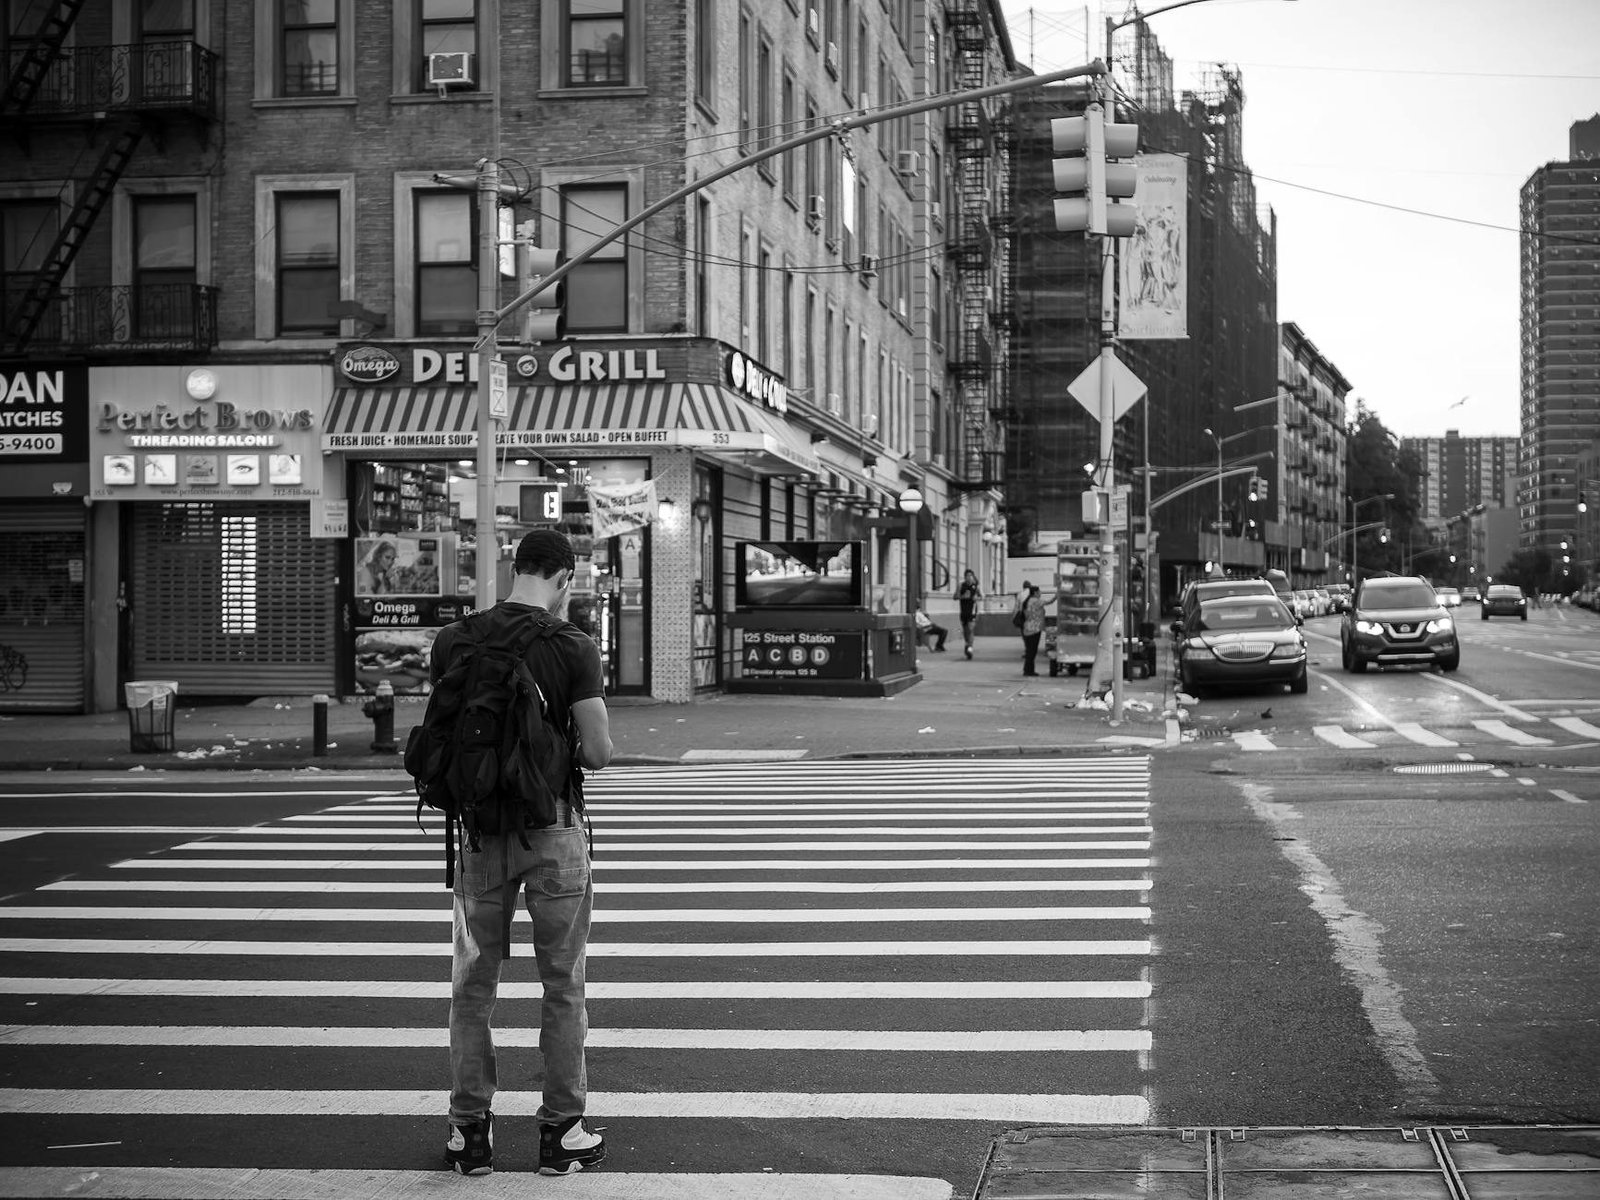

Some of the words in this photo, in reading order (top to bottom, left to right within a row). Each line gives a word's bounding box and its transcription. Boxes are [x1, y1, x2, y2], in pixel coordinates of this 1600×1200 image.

[343, 357, 399, 377] Omega
[550, 346, 665, 381] GRILL
[0, 371, 63, 404] AN
[96, 402, 208, 431] Perfect
[215, 402, 314, 431] Brows
[131, 435, 217, 447] THREADING
[330, 435, 358, 446] FRESH
[361, 435, 385, 446] JUICE
[394, 434, 445, 445] HOMEMADE
[449, 434, 473, 445] SOUP
[518, 433, 542, 444] YOUR
[545, 432, 567, 443] OWN
[570, 432, 599, 443] SALAD
[608, 432, 632, 442] OPEN
[635, 431, 668, 442] BUFFET
[625, 538, 635, 551] A
[374, 601, 416, 614] Omega
[372, 615, 389, 624] Deli
[391, 615, 398, 624] &
[400, 615, 420, 624] Grill
[744, 633, 760, 643] 125
[764, 633, 795, 643] Street
[798, 633, 835, 644] Station
[748, 649, 759, 661] A
[770, 649, 781, 661] C
[792, 649, 803, 661] B
[814, 649, 826, 661] D
